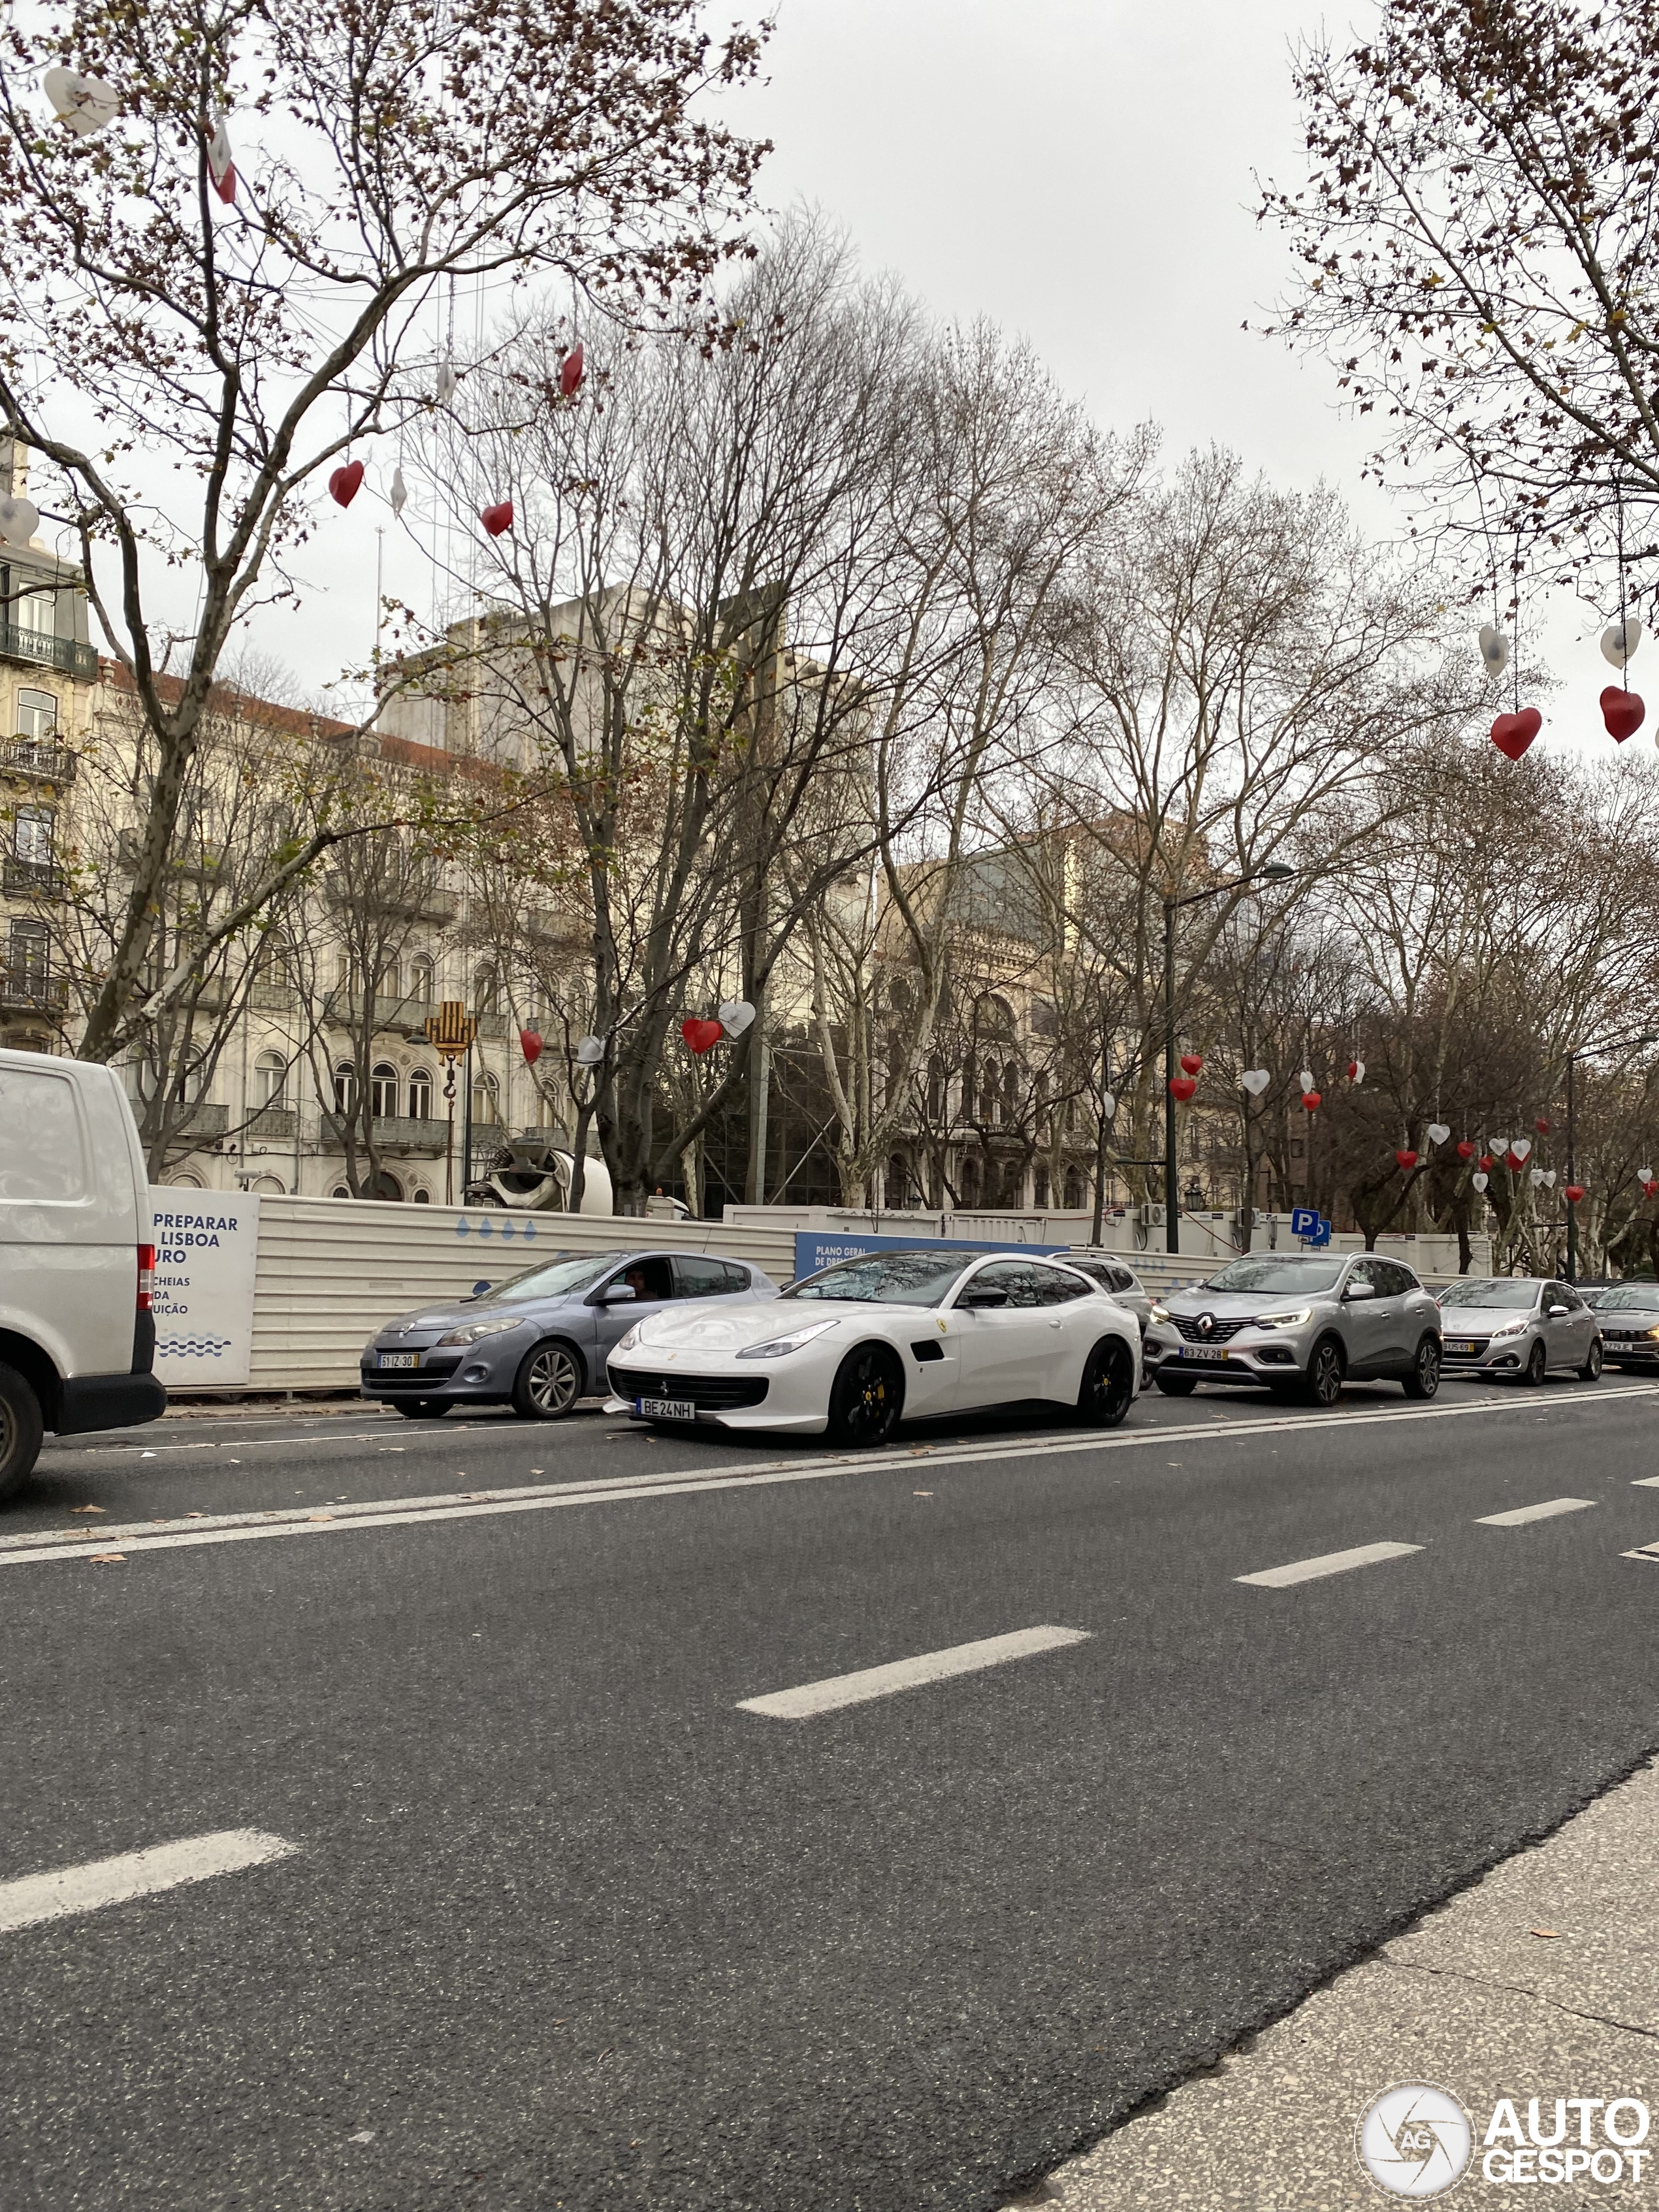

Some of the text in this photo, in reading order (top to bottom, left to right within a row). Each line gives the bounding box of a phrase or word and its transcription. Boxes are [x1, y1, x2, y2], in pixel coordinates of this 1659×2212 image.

[153, 1213, 237, 1230] PREPARAR
[1298, 1213, 1313, 1231] P
[161, 1232, 219, 1247] LISBOA
[155, 1249, 186, 1263] URO
[816, 1246, 865, 1257] PLANO GERAL
[815, 1257, 824, 1266] DE
[153, 1303, 187, 1316] UIÇÃO
